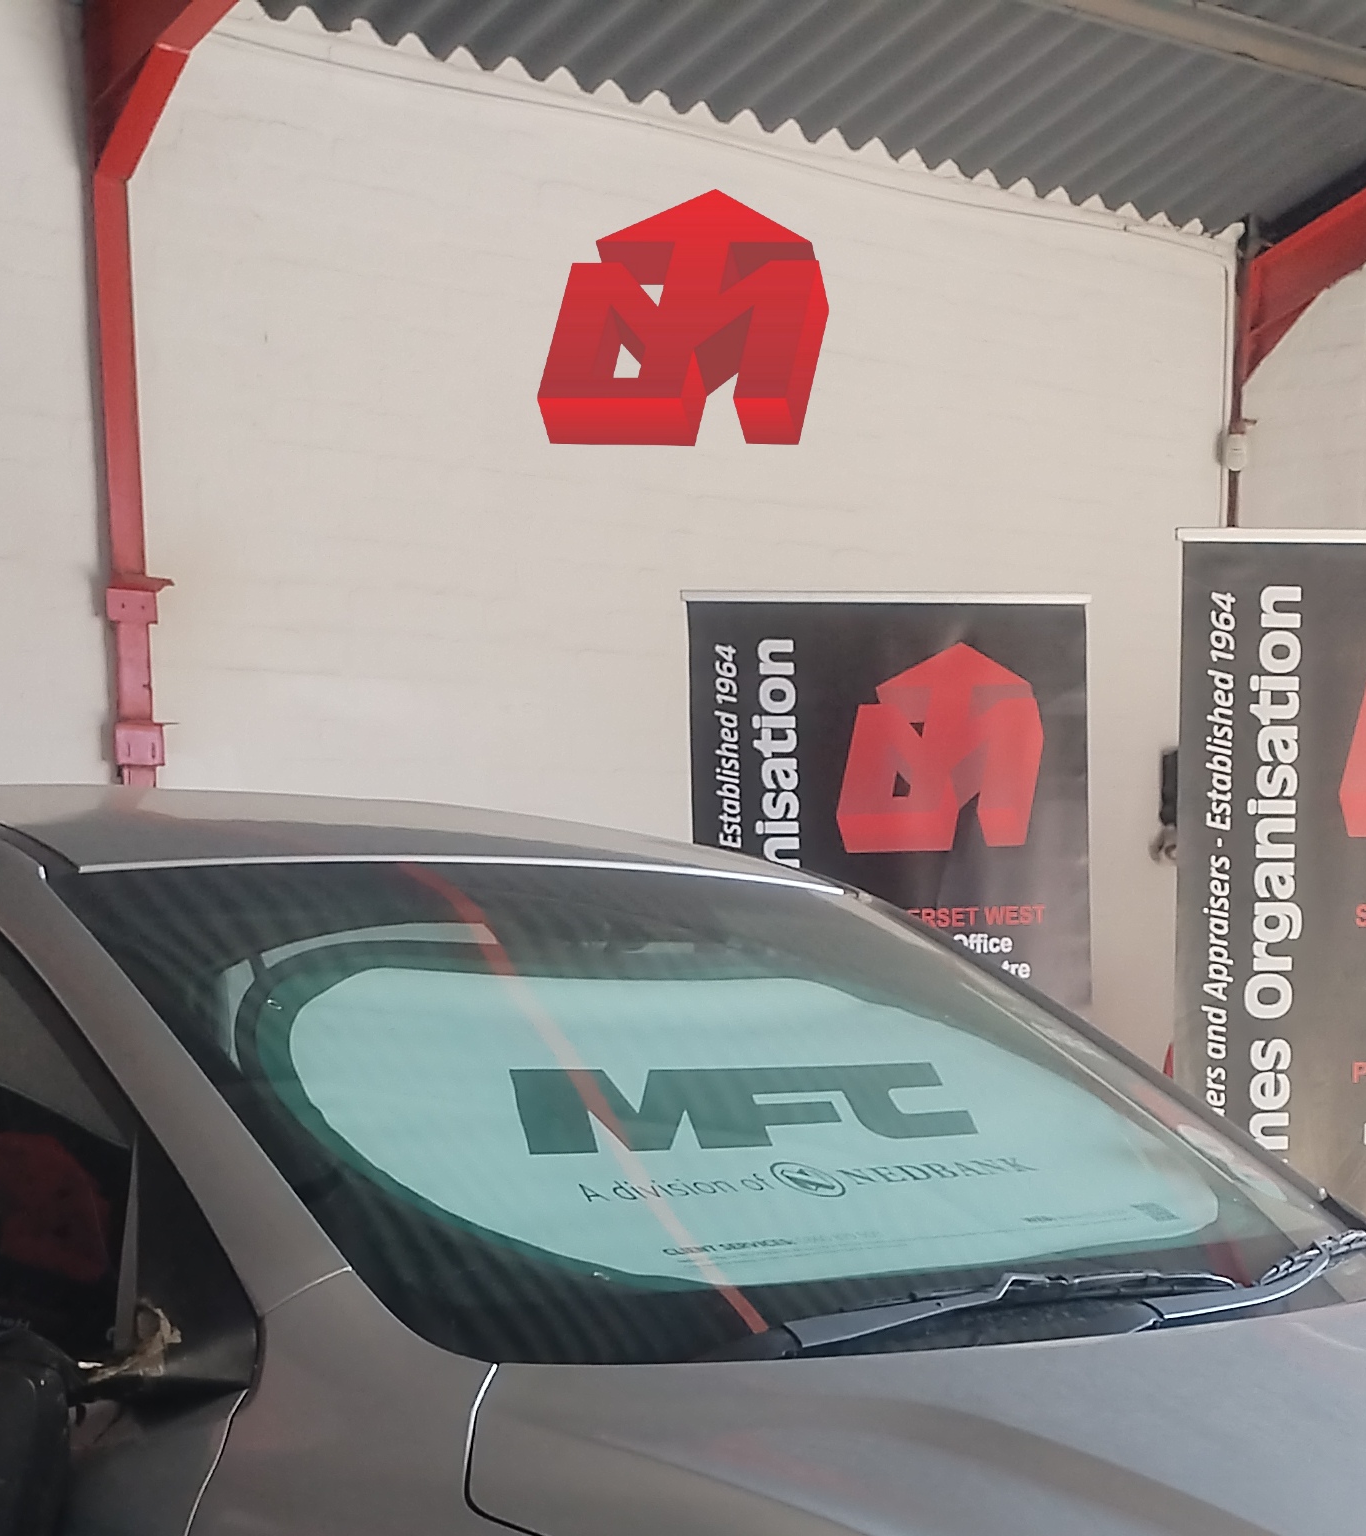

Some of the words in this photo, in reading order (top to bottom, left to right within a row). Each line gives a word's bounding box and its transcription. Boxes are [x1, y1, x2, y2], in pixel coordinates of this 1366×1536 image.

[1210, 592, 1236, 662] 1964
[715, 644, 737, 704] 1964
[714, 711, 742, 849] Established
[1205, 669, 1235, 831] Established
[1244, 585, 1303, 1020] Organisation
[984, 904, 1046, 926] WEST
[1202, 855, 1235, 1001] Appraisers
[1201, 1005, 1228, 1060] and
[510, 1062, 976, 1155] MFC
[580, 1183, 605, 1203] A
[614, 1176, 733, 1202] division
[741, 1172, 773, 1194] of
[837, 1157, 1038, 1187] NEDBANK
